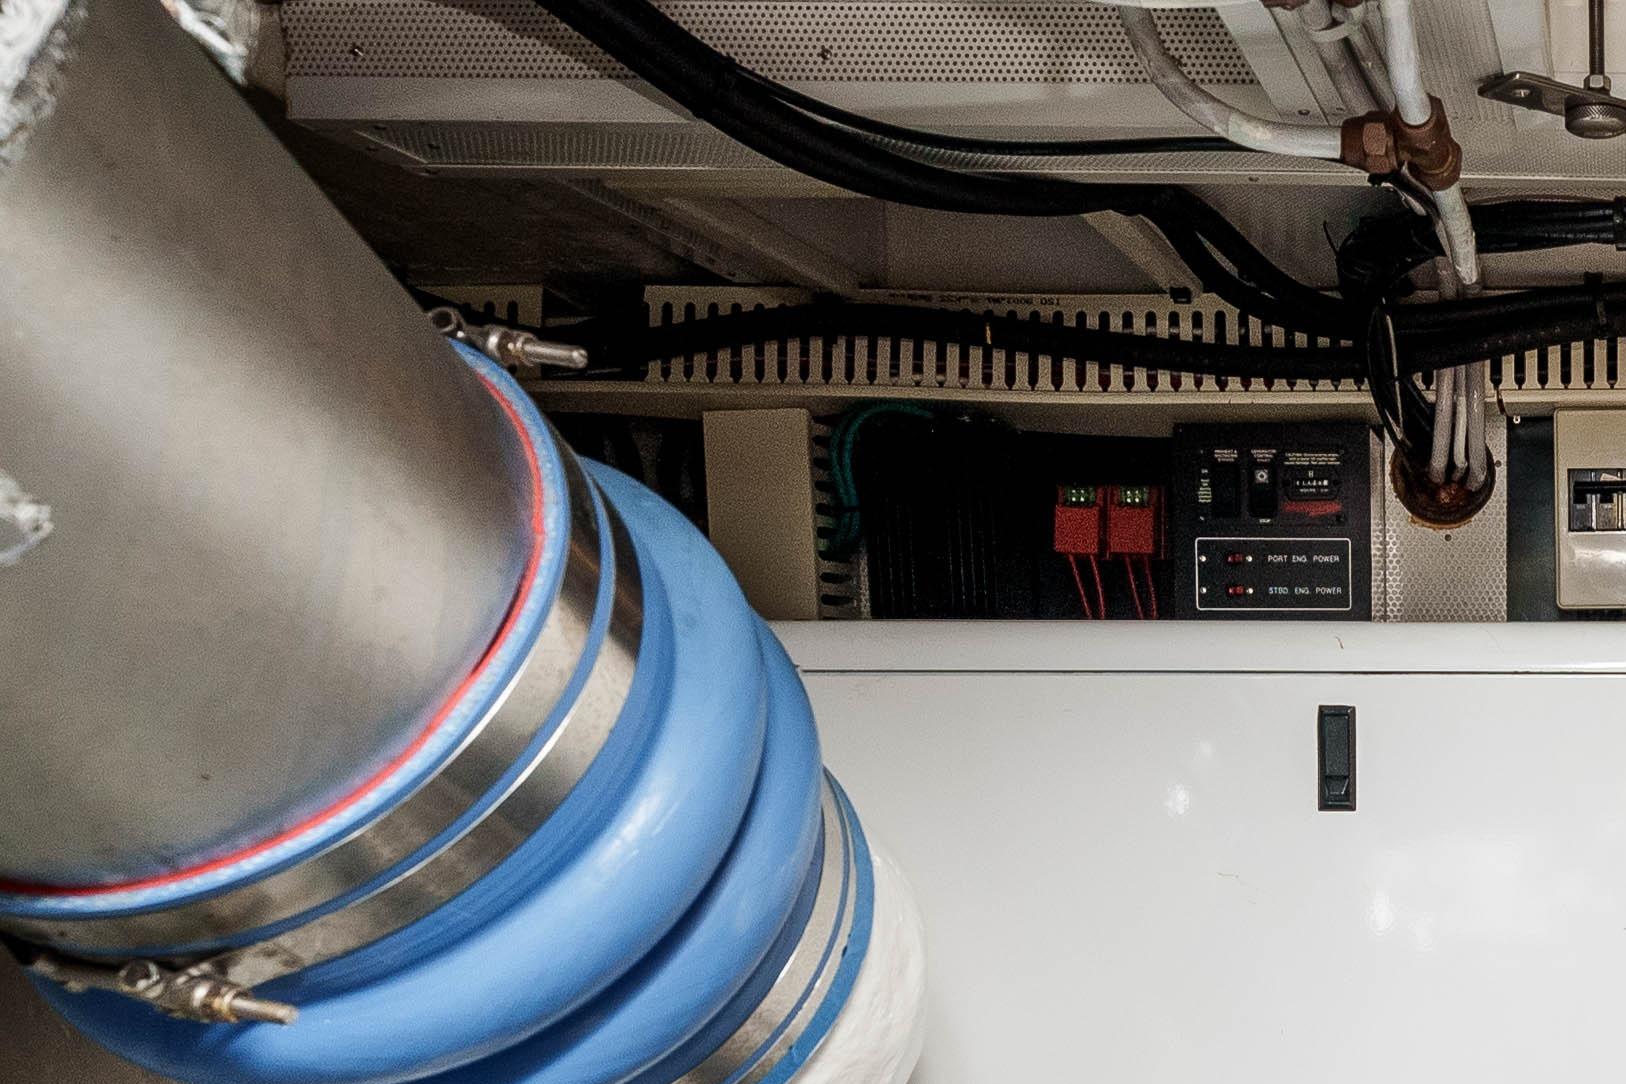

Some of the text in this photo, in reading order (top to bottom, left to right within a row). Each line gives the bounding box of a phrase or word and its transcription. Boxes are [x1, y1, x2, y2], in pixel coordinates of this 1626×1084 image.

[1267, 555, 1288, 563] PORT
[1312, 555, 1340, 563] POWER
[1315, 587, 1342, 595] POWER
